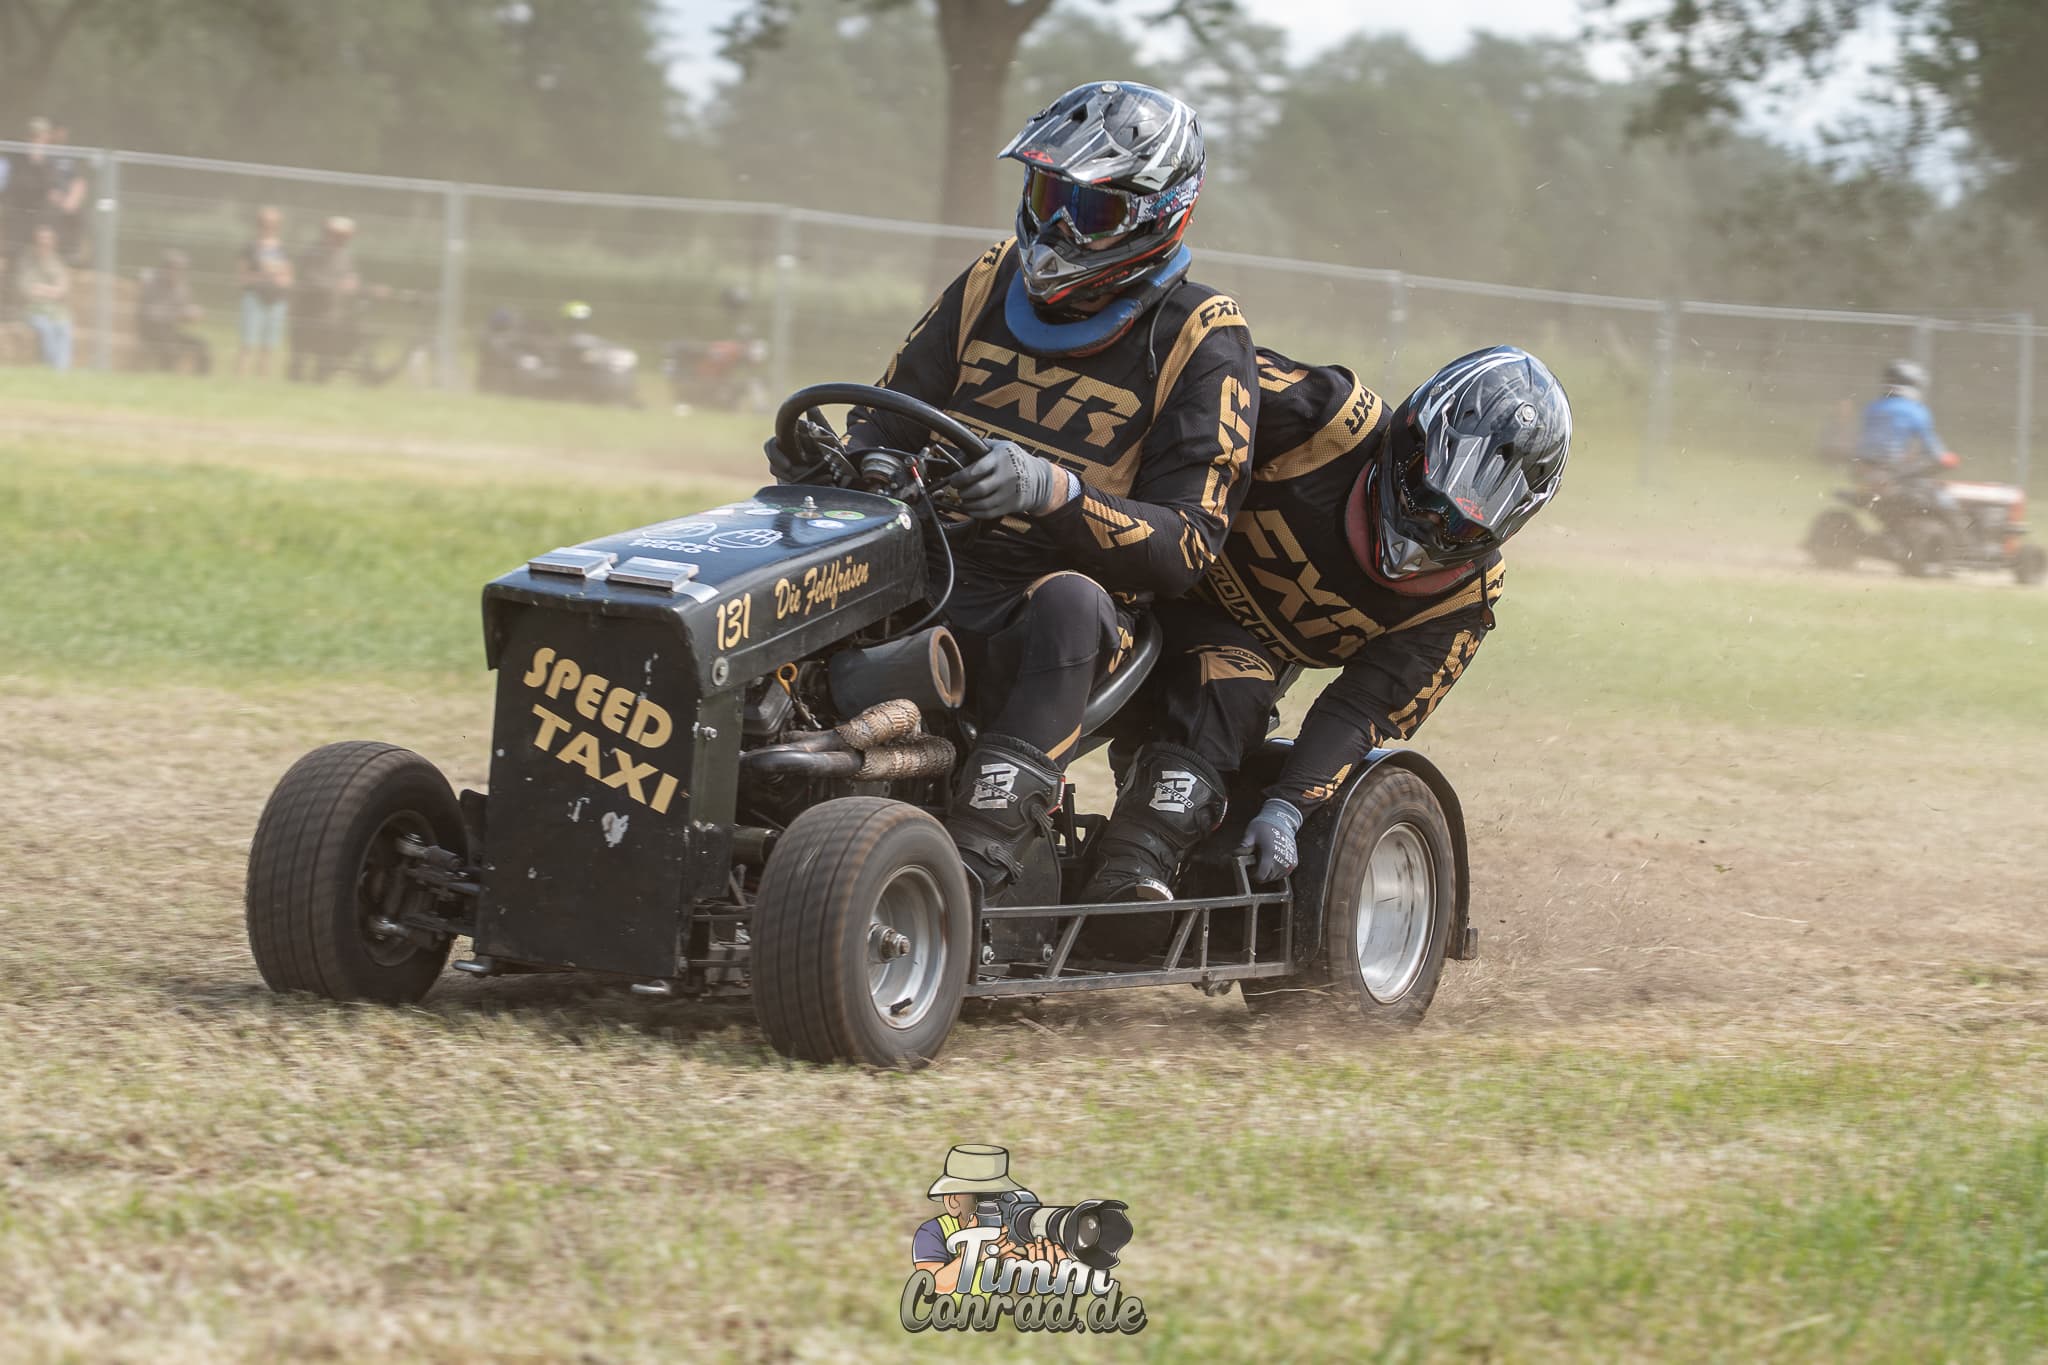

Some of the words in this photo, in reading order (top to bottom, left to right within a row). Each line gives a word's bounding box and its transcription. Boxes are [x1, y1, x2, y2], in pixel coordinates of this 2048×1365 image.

[953, 340, 1142, 448] FXR
[716, 592, 751, 650] 131
[774, 577, 801, 620] Die
[803, 555, 870, 616] Feldfräsen
[1232, 509, 1386, 659] FXR
[523, 647, 673, 749] SPEED
[532, 704, 678, 815] TAXI
